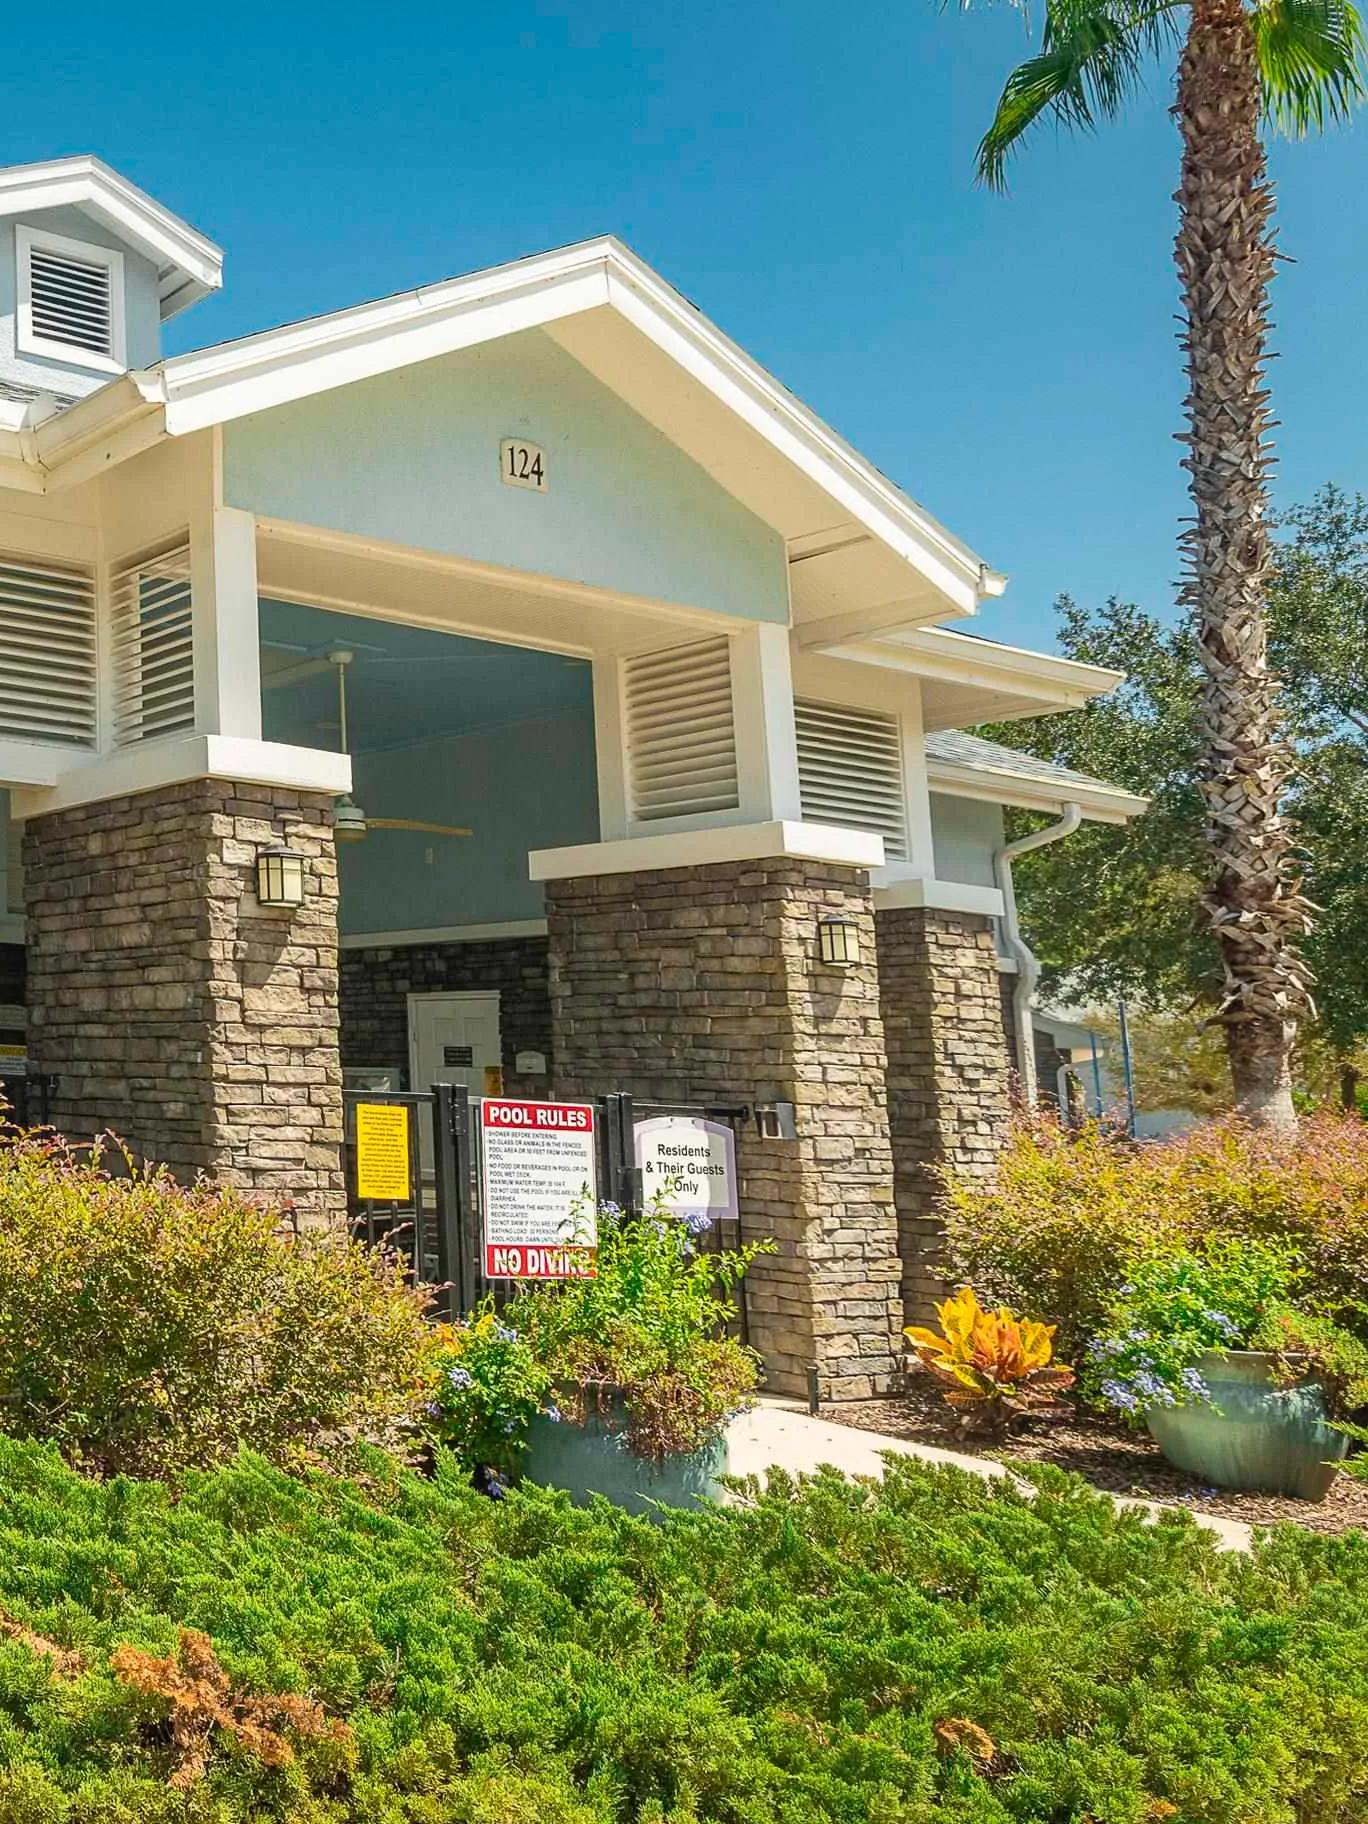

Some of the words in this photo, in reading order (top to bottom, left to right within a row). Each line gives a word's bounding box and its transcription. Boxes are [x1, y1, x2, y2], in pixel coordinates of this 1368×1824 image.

[508, 445, 544, 486] 124
[489, 1106, 533, 1125] POOL
[536, 1108, 587, 1127] RULES
[657, 1143, 711, 1158] Residents
[645, 1161, 653, 1173] &
[656, 1161, 684, 1174] Their
[687, 1162, 725, 1176] Guests
[674, 1180, 699, 1195] Only
[494, 1248, 522, 1275] NO
